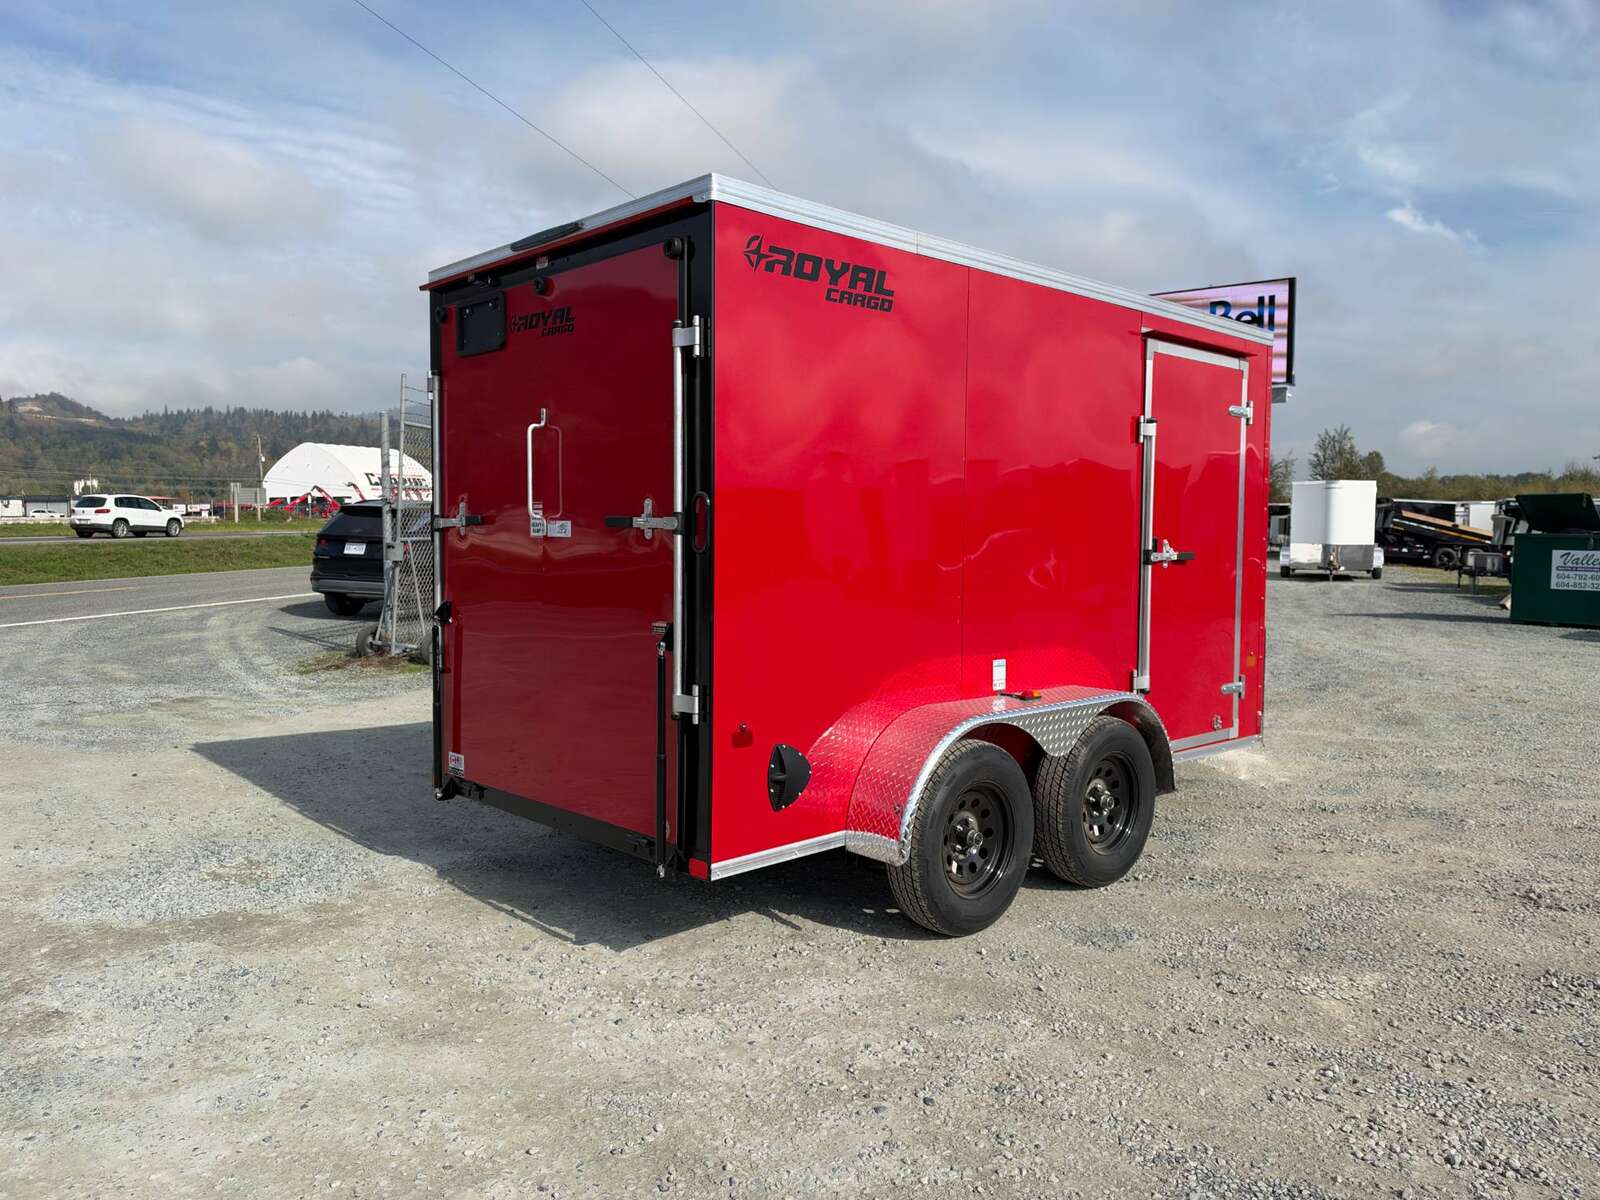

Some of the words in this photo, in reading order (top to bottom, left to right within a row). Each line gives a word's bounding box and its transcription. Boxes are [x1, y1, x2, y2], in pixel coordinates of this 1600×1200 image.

[764, 245, 894, 297] ROYAL
[825, 288, 894, 313] CARGO
[517, 306, 576, 332] ROYAL
[540, 323, 575, 337] CARGO
